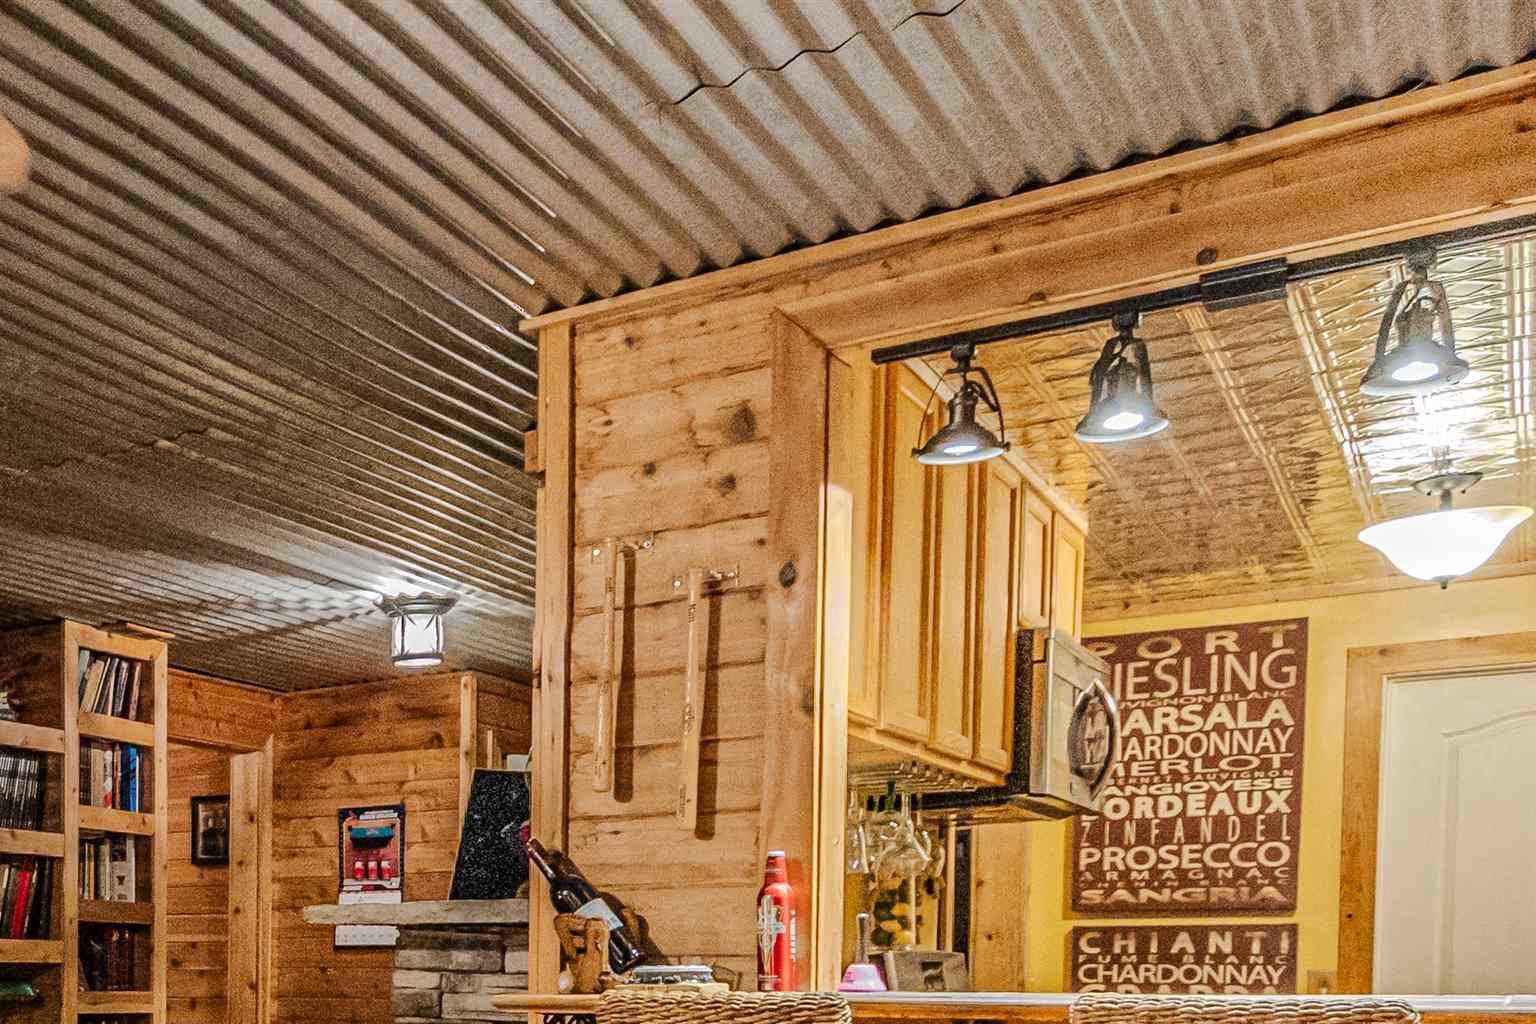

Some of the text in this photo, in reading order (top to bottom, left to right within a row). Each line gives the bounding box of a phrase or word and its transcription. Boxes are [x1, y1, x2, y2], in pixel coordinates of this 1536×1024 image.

[1085, 624, 1298, 659] PORT
[1115, 648, 1298, 700] IESLING
[1220, 689, 1292, 702] BLANC
[1117, 699, 1295, 737] ARSALA
[1116, 727, 1294, 761] ARDONNAY
[1104, 778, 1294, 797] ANGIOVESE
[1119, 769, 1294, 787] ERNET SAUVIGNON
[1103, 790, 1293, 820] ORDEAUX
[1081, 814, 1291, 846] ZINFANDEL
[1079, 841, 1291, 871] PROSECCO
[1080, 867, 1289, 881] ARMAGNAC
[1079, 886, 1288, 904] SANGRIA
[1078, 931, 1291, 954] CHIANTI
[1182, 955, 1288, 964] BLANC
[1077, 964, 1288, 985] CHARDONNAY
